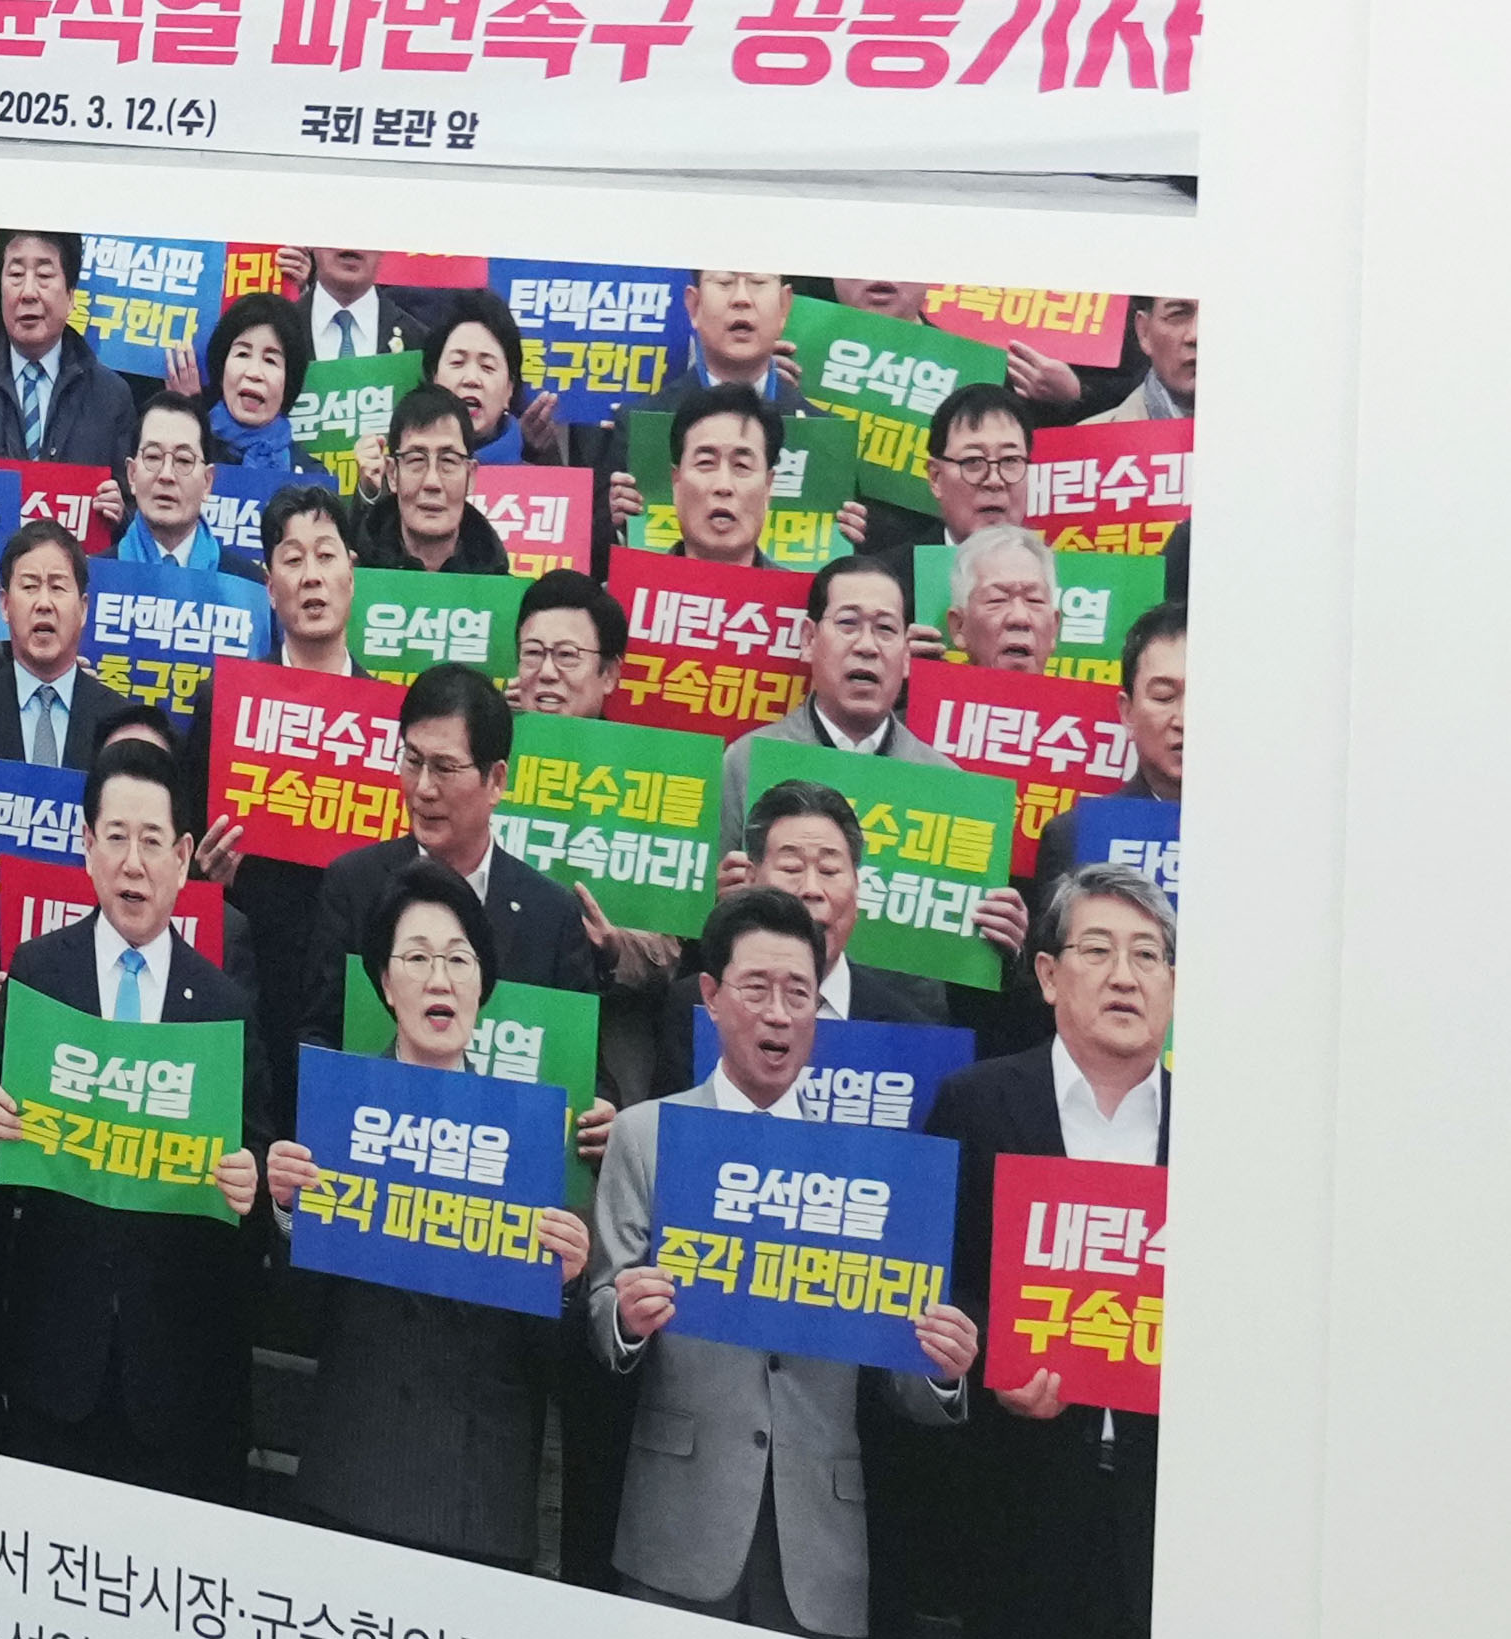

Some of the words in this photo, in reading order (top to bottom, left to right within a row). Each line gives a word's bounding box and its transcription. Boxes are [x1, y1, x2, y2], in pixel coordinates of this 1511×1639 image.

[87, 95, 113, 130] 3.
[126, 97, 217, 138] 12.(수)
[301, 104, 364, 144] 국회
[373, 108, 435, 149] 본관
[447, 110, 479, 150] 앞
[508, 279, 672, 334] 탄핵심판
[287, 384, 395, 443] 윤석열
[820, 337, 959, 418] 윤석열
[94, 592, 254, 659] 탄핵심판
[363, 602, 492, 663] 윤석열
[619, 653, 808, 726] 구속하라
[233, 695, 402, 774] 내란수괴
[933, 699, 1137, 783] 내란수괴
[502, 755, 707, 829] 내란수괴를
[848, 798, 998, 875] 수괴를
[49, 1042, 196, 1120] 윤석열
[19, 1098, 224, 1186] 즉각파면!
[349, 1105, 511, 1187] 윤석열을
[298, 1167, 379, 1233] 즉각
[712, 1162, 891, 1242] 윤석열을
[656, 1224, 745, 1295] 즉각
[748, 1242, 945, 1322] 파면하라!
